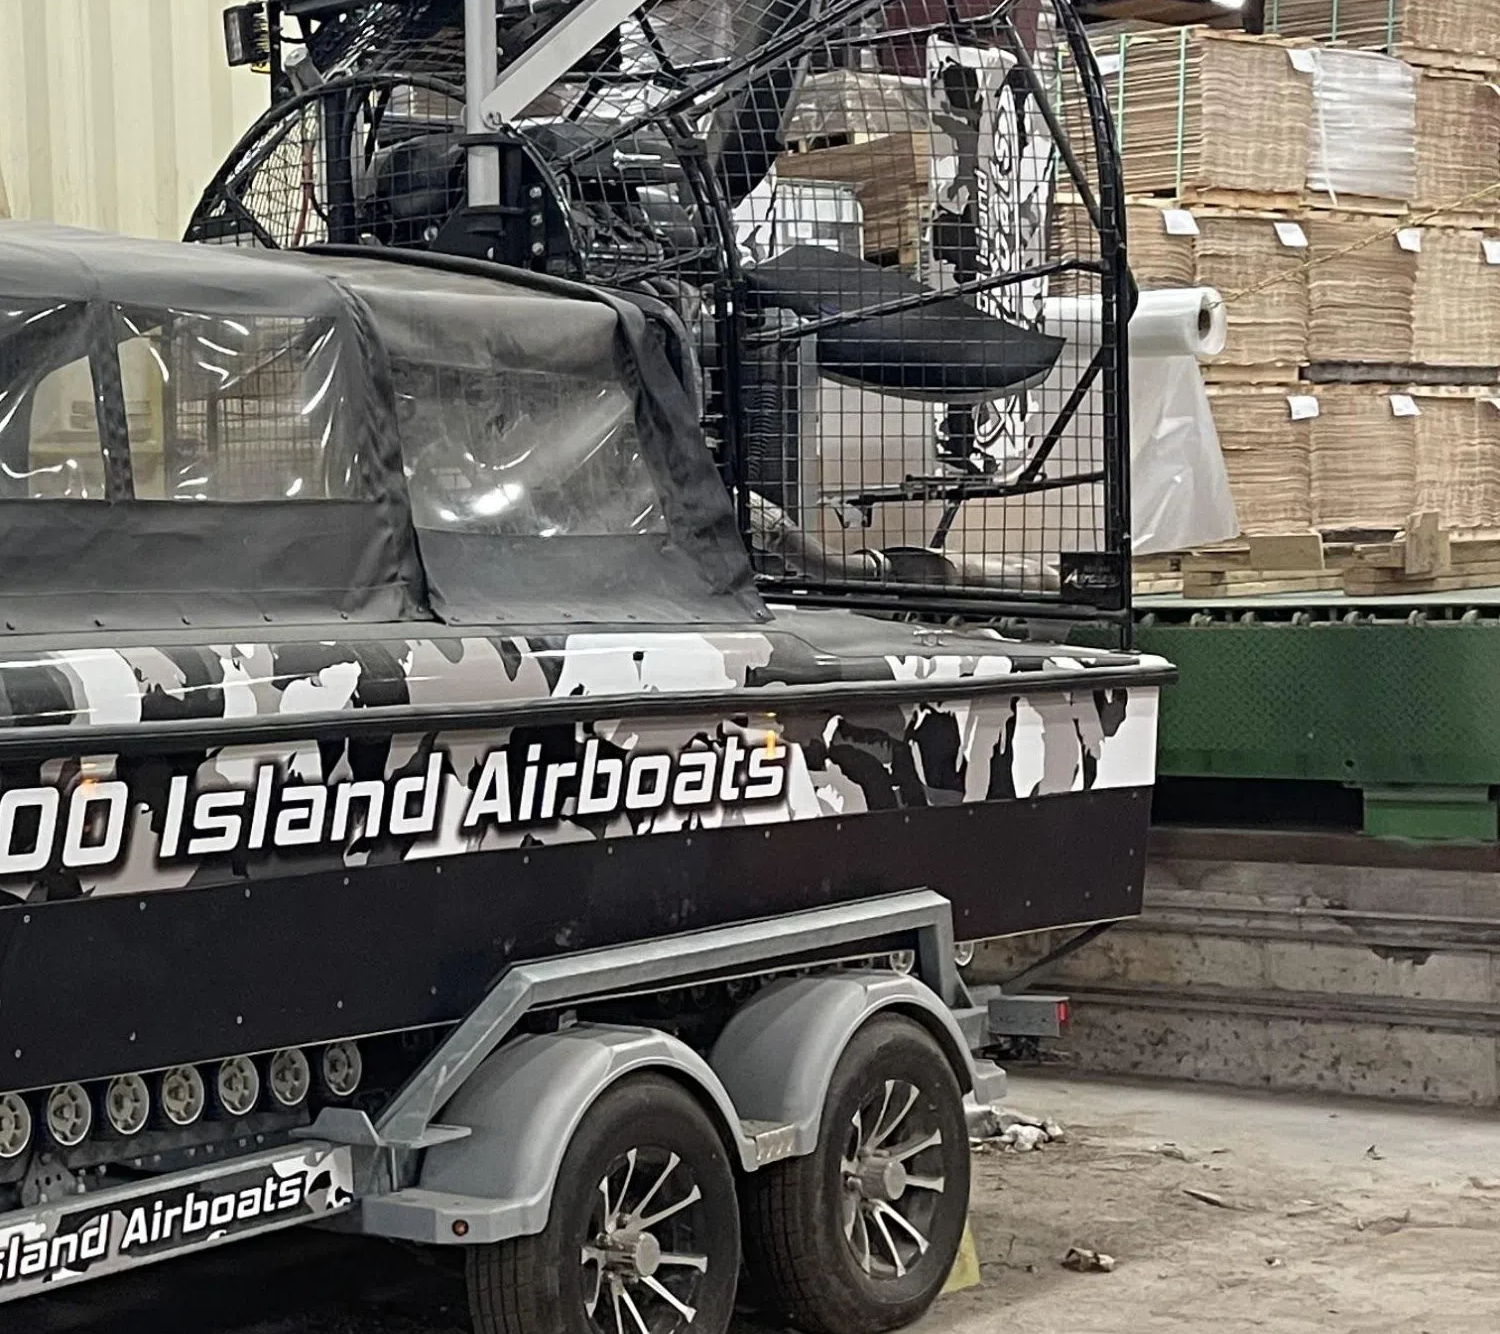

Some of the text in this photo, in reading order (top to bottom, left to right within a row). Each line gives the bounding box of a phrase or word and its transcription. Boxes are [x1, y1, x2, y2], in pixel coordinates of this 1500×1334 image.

[158, 752, 441, 858] Island
[462, 735, 787, 827] Airboats
[120, 1177, 303, 1250] Airboats
